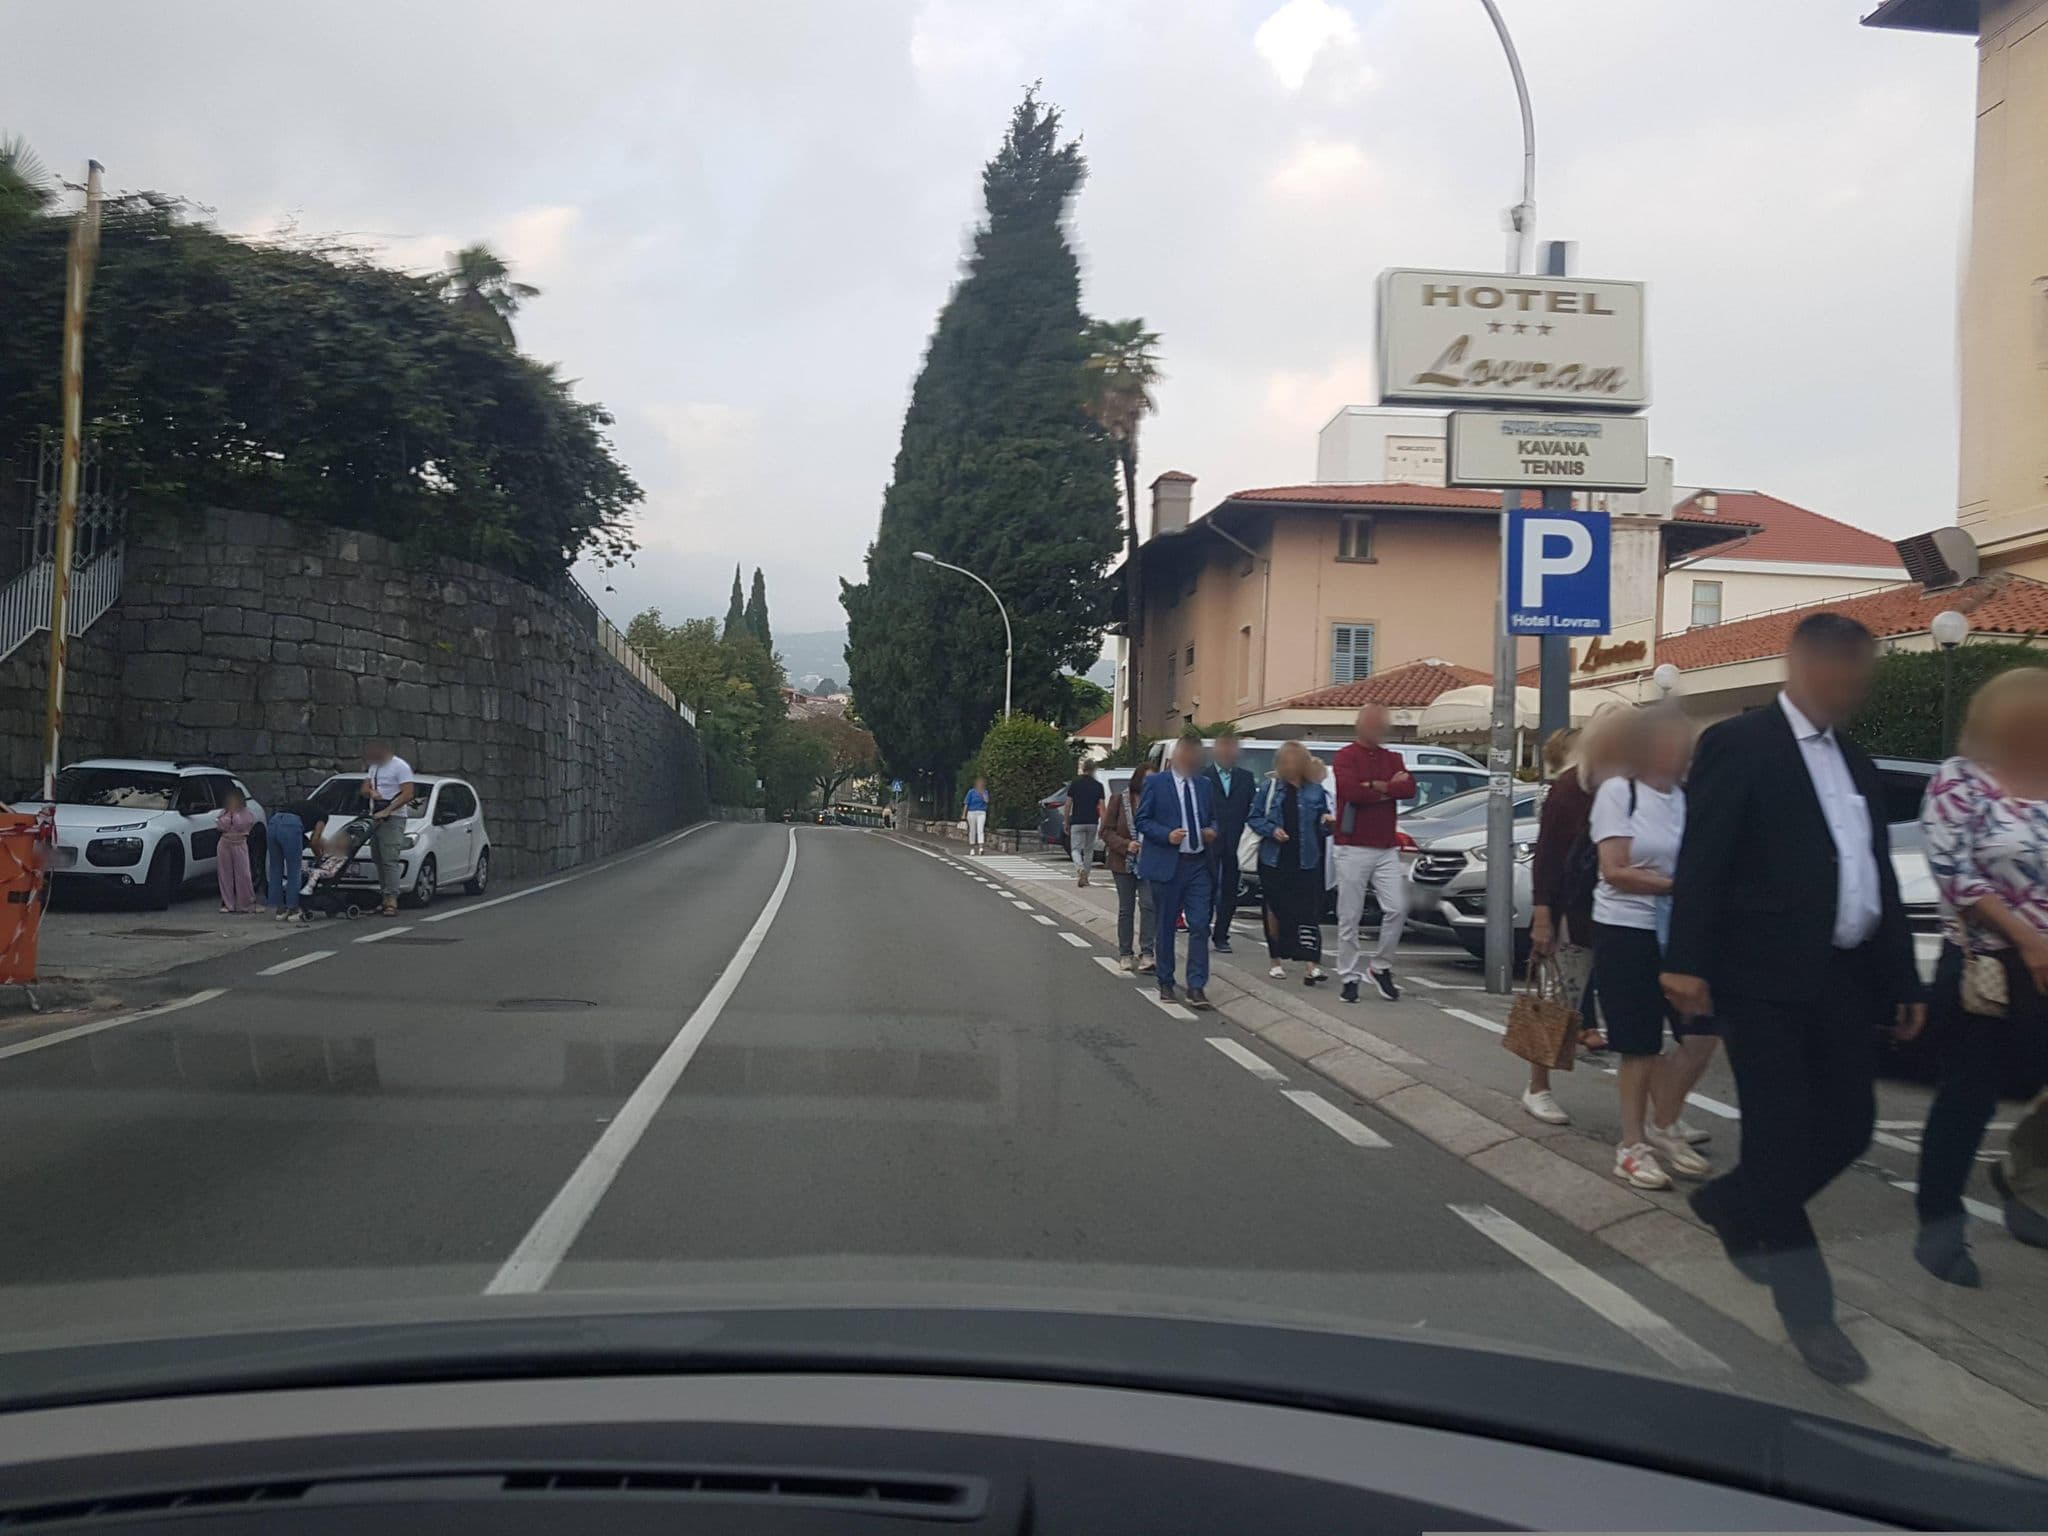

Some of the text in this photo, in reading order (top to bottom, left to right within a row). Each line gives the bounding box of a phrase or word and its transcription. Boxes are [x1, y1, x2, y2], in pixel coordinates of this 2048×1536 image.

[1421, 284, 1615, 315] HOTEL
[1517, 440, 1589, 456] KAVANA
[1520, 460, 1584, 475] TENNIS
[1521, 518, 1593, 608] P
[1512, 614, 1601, 628] Hotel Lovran
